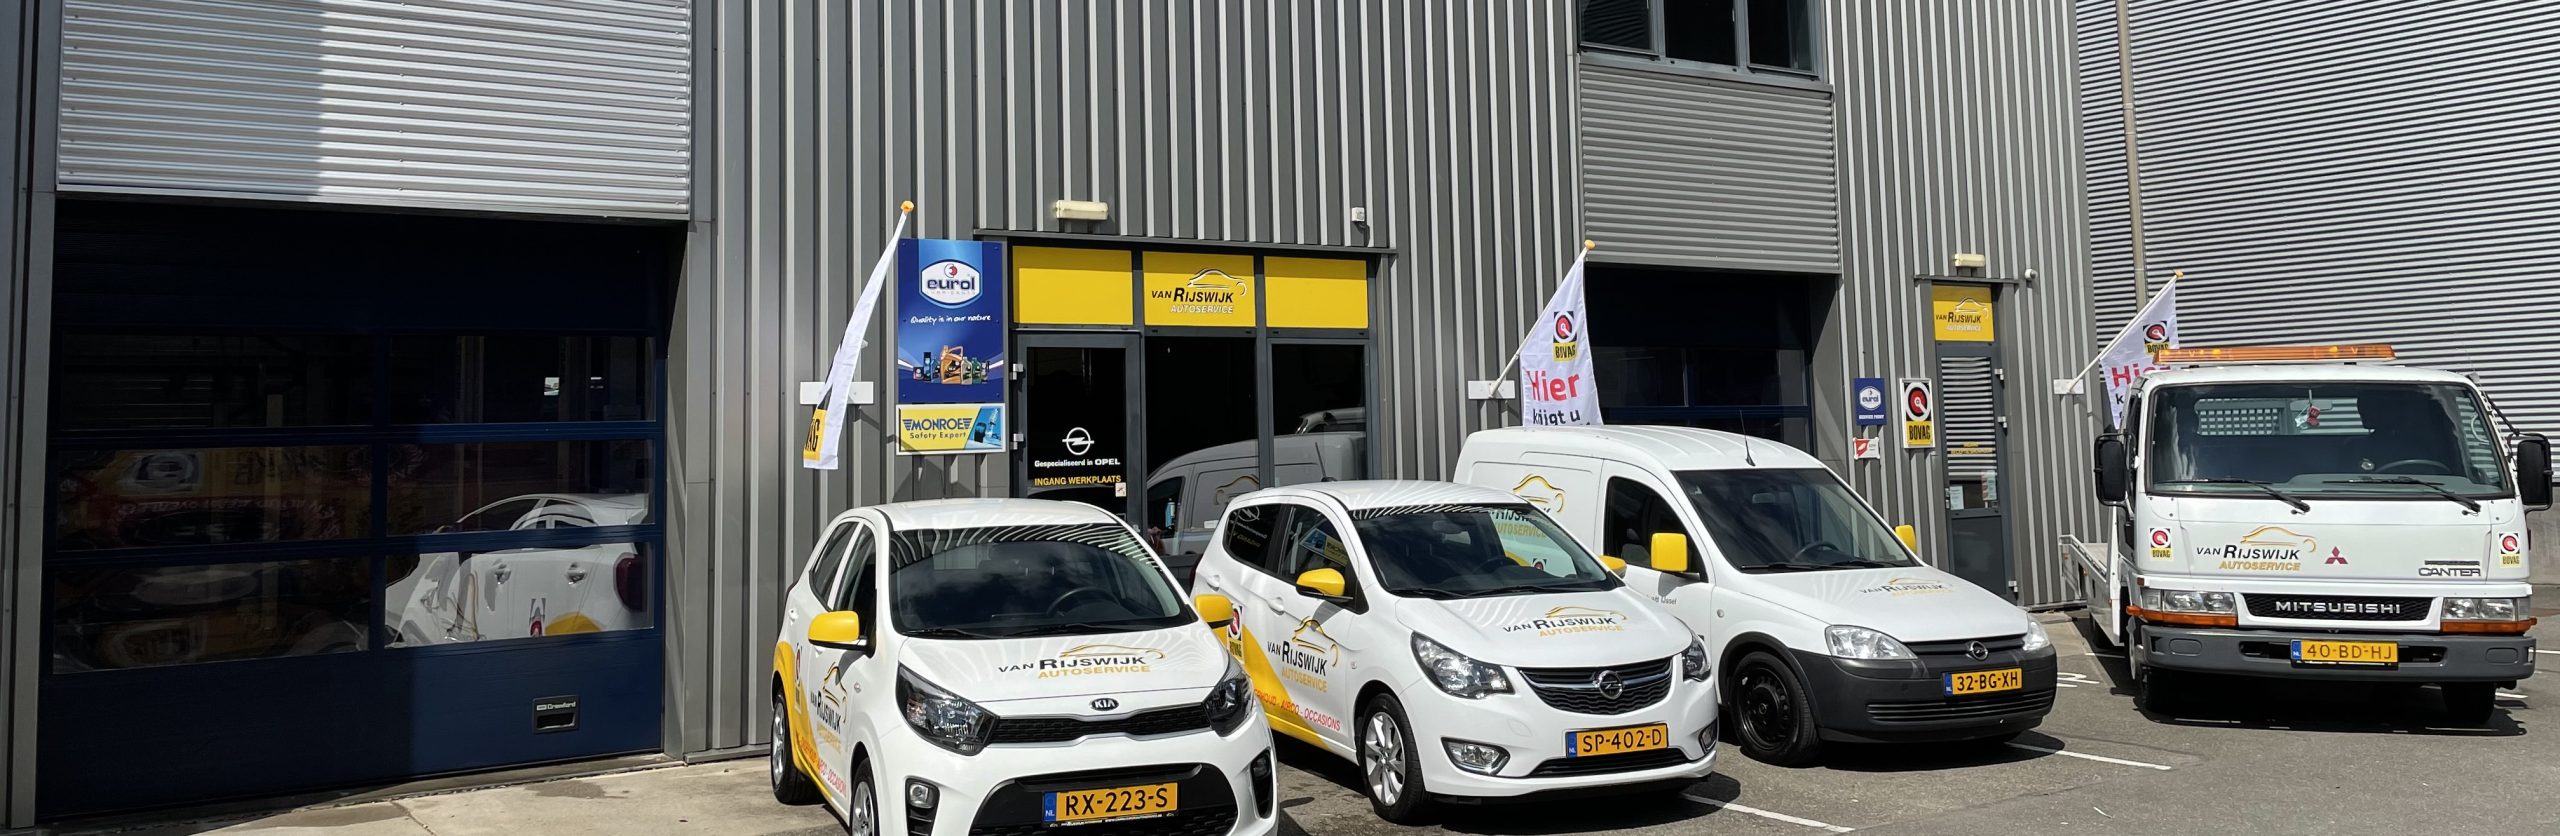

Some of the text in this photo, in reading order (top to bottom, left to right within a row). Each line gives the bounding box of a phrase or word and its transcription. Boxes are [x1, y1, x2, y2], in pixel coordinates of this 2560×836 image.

[927, 276, 975, 290] eurol
[1152, 287, 1234, 303] VAN RIJSWIJK
[1170, 304, 1233, 314] AUTOSERVICE
[910, 315, 937, 325] Quality
[968, 313, 991, 321] nature
[1948, 311, 1982, 323] RIJSWIJK
[1526, 370, 1580, 401] Hier
[911, 418, 965, 431] MONROE
[910, 431, 967, 440] Safety Expert
[1909, 424, 1931, 440] BOVAG
[1034, 459, 1086, 469] Gespecialiseerd
[1094, 458, 1121, 466] OPEL
[1034, 475, 1121, 486] INGANG WERKPLAATS
[2152, 550, 2171, 559] BOVAG
[2196, 544, 2301, 560] VAN RIJSWIJK
[2219, 560, 2301, 571] AUTOSERVICE
[2418, 567, 2481, 577] CANTER
[2275, 601, 2401, 614] MITSUBISHI
[1503, 617, 1617, 633] VAN RIJSWIJK
[1539, 625, 1625, 638] AUTOSERVICE
[1267, 640, 1328, 677] VAN RIJSWIJK
[2307, 644, 2392, 660] 40-BD-HJ
[998, 656, 1146, 673] VAN RIJSWIJK
[1038, 665, 1151, 680] AUTOSERVICE
[1957, 671, 2018, 692] 32-BG-XH
[1095, 699, 1116, 709] KIA
[1304, 707, 1341, 732] OCCASIONS
[1583, 728, 1662, 753] SP-402-D
[1065, 787, 1168, 816] RX-223-S
